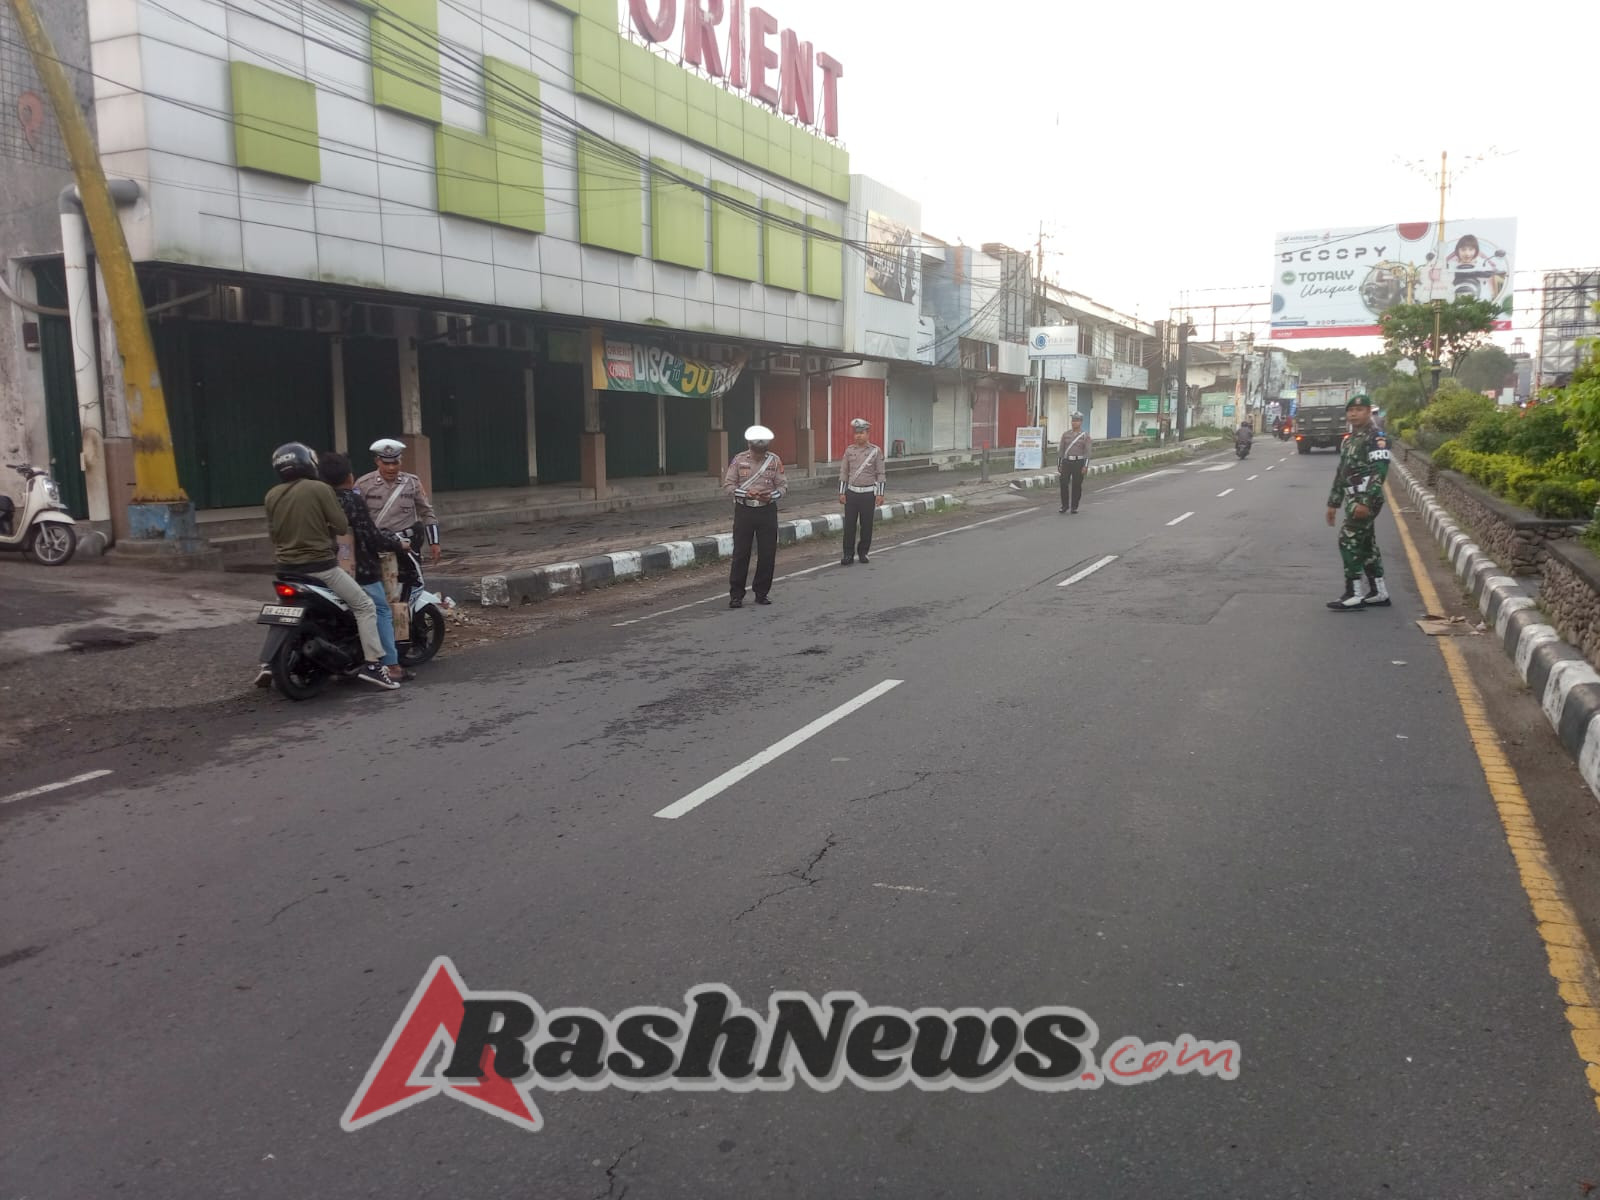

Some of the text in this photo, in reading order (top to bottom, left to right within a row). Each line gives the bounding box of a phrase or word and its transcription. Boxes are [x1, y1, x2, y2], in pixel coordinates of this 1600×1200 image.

[1281, 245, 1387, 263] SCOOPY
[1298, 269, 1355, 283] TOTALLY
[1299, 284, 1358, 299] Unique
[633, 343, 675, 385] DISC
[671, 368, 680, 382] TO
